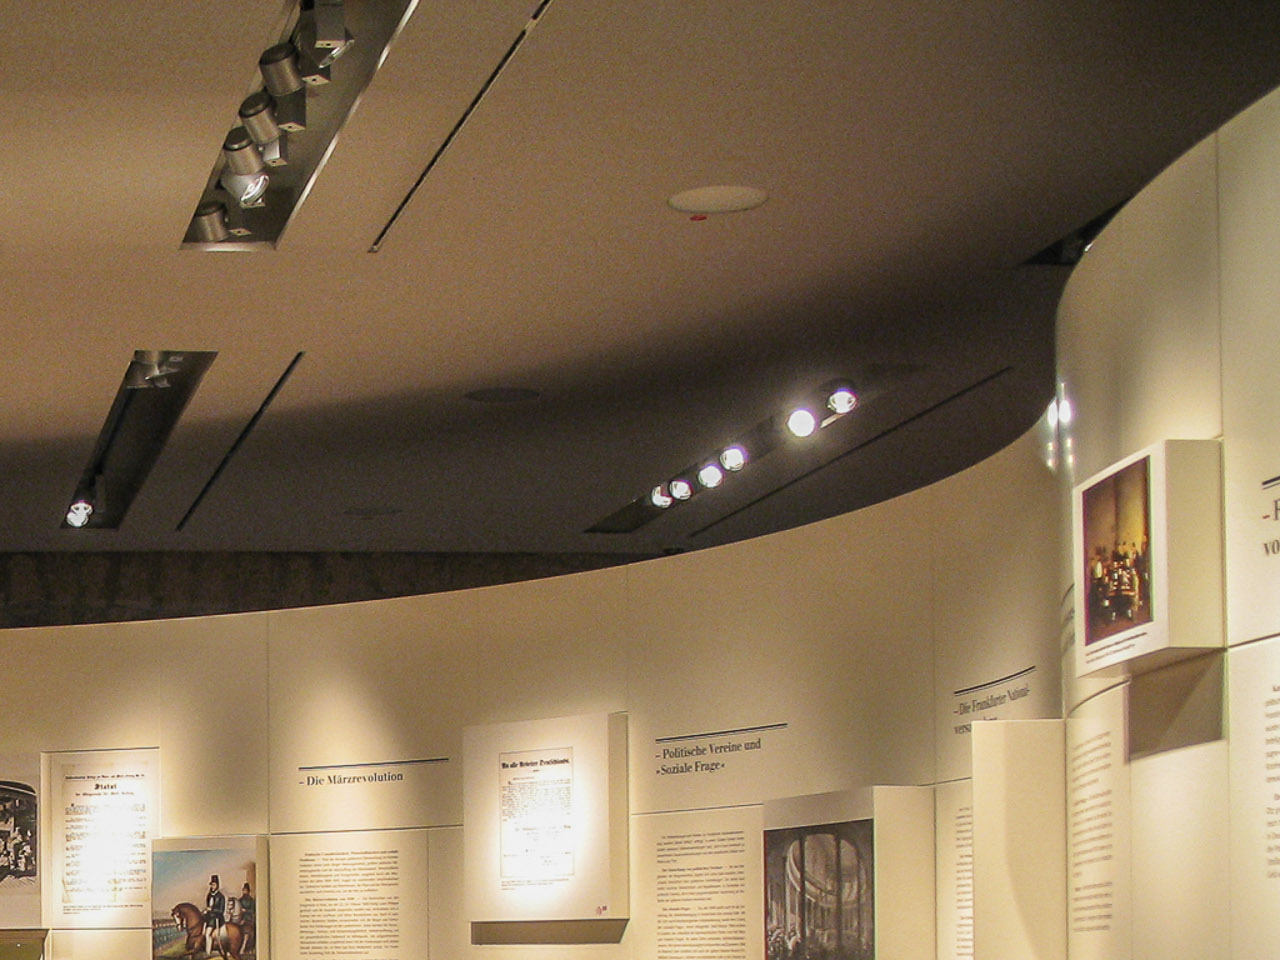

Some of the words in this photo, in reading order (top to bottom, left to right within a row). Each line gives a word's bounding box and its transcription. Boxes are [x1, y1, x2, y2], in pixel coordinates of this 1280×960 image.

[663, 745, 707, 759] Politische
[709, 742, 742, 754] Vereine
[744, 738, 761, 751] und
[306, 775, 324, 786] Die
[327, 772, 403, 785] Märzrevolution
